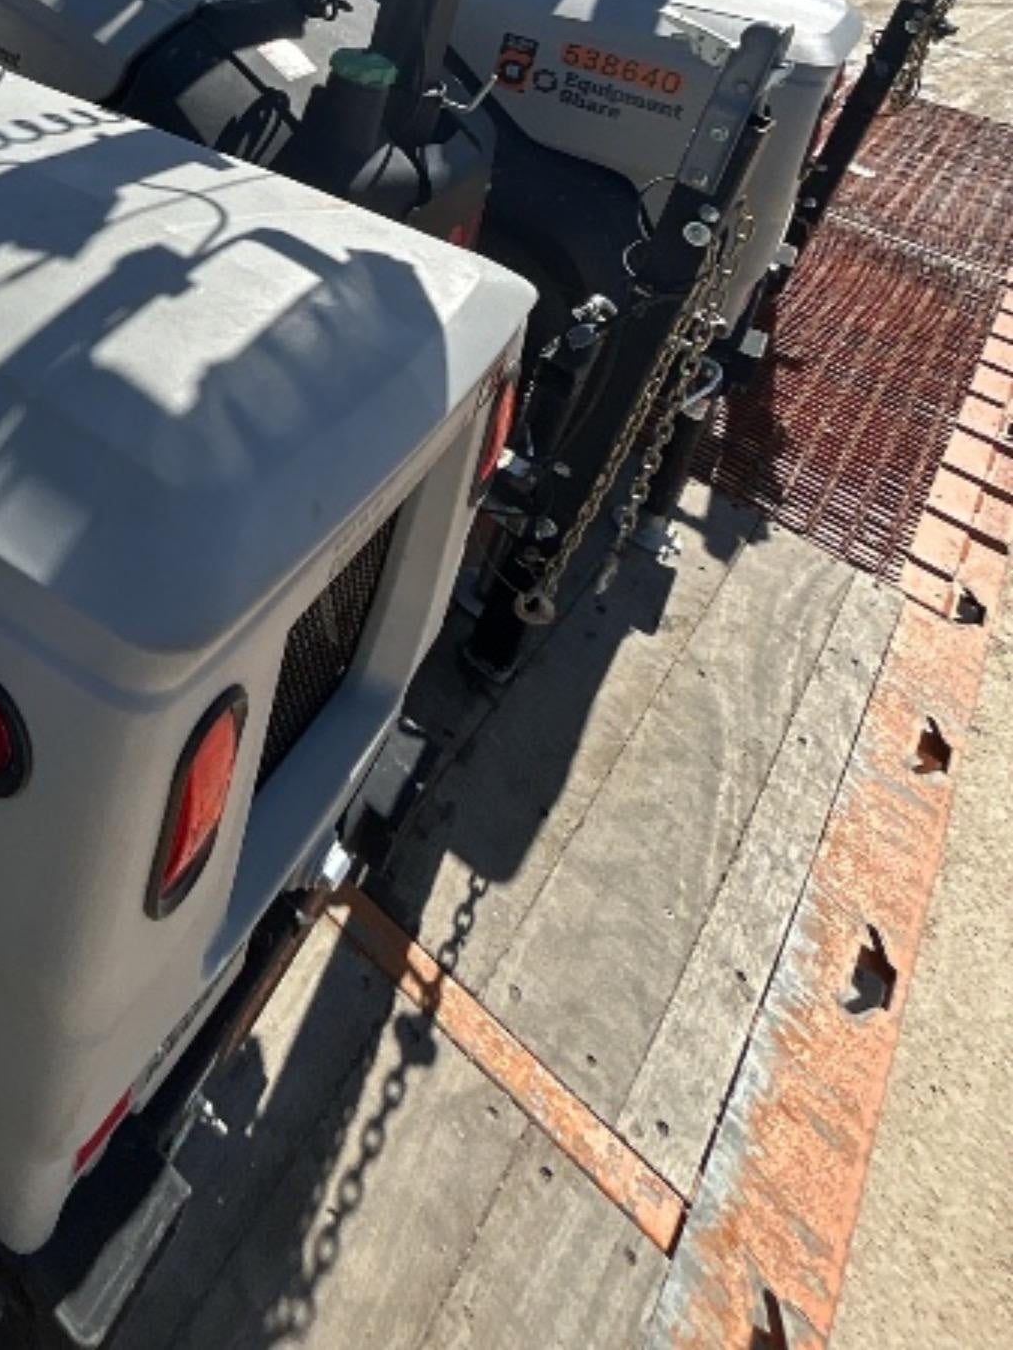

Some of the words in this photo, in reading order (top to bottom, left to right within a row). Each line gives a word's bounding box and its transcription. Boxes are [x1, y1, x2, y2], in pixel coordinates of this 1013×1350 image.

[562, 43, 682, 94] 538640
[559, 89, 621, 120] Share
[564, 71, 685, 121] Equipment
